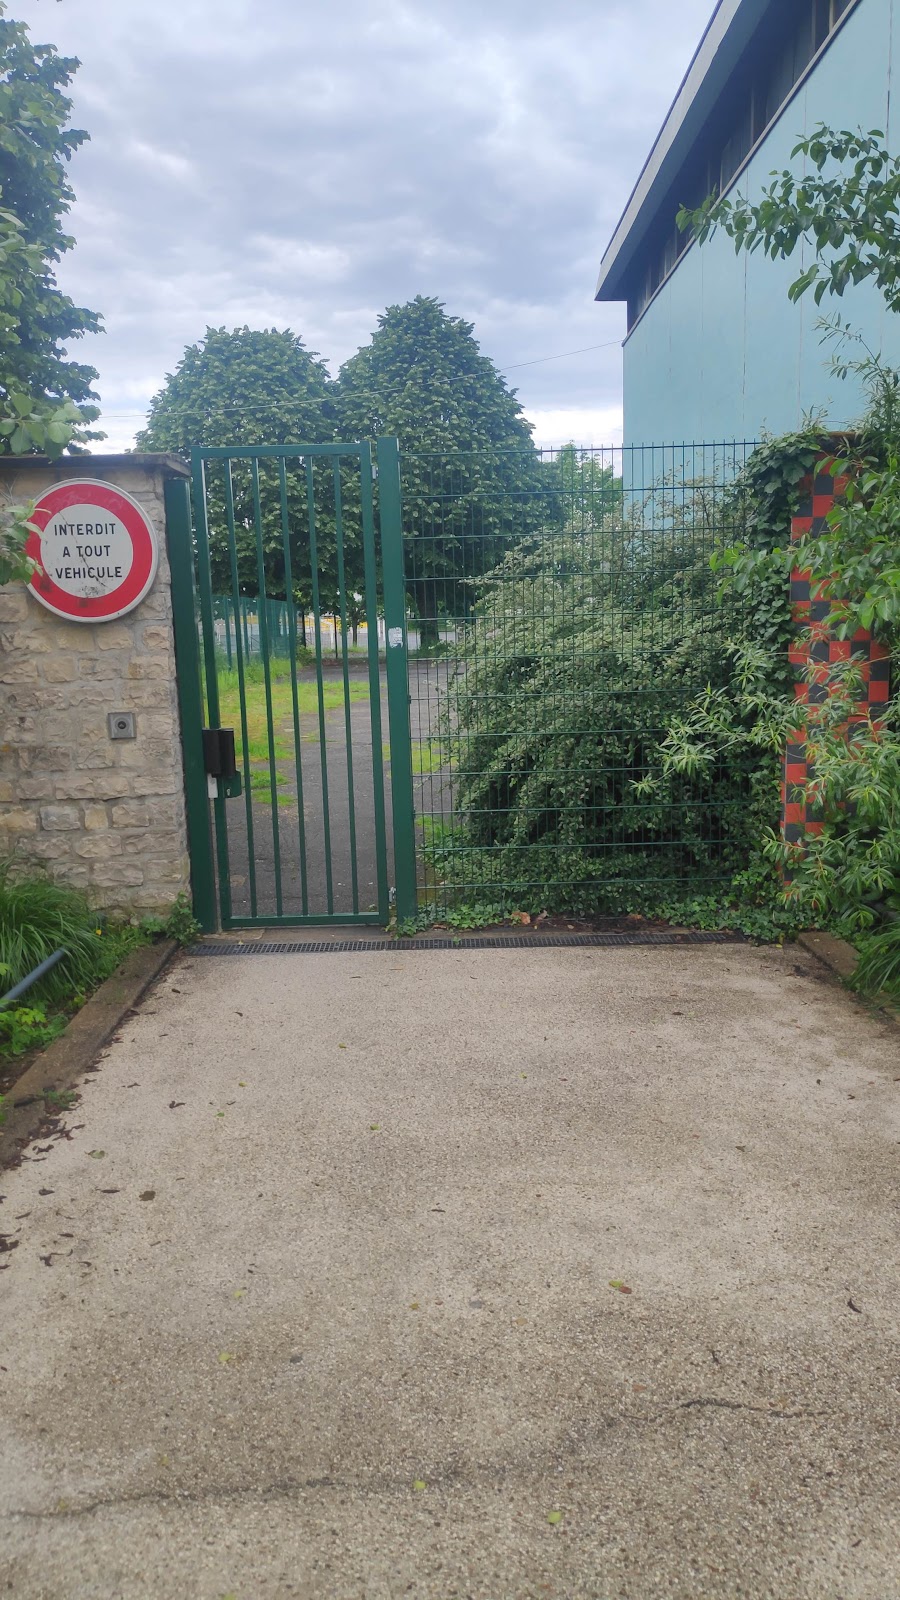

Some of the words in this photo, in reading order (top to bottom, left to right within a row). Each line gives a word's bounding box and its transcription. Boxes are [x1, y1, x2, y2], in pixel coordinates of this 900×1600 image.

[54, 523, 116, 536] INTERDIT
[62, 546, 71, 558] A
[76, 545, 111, 557] TOUT
